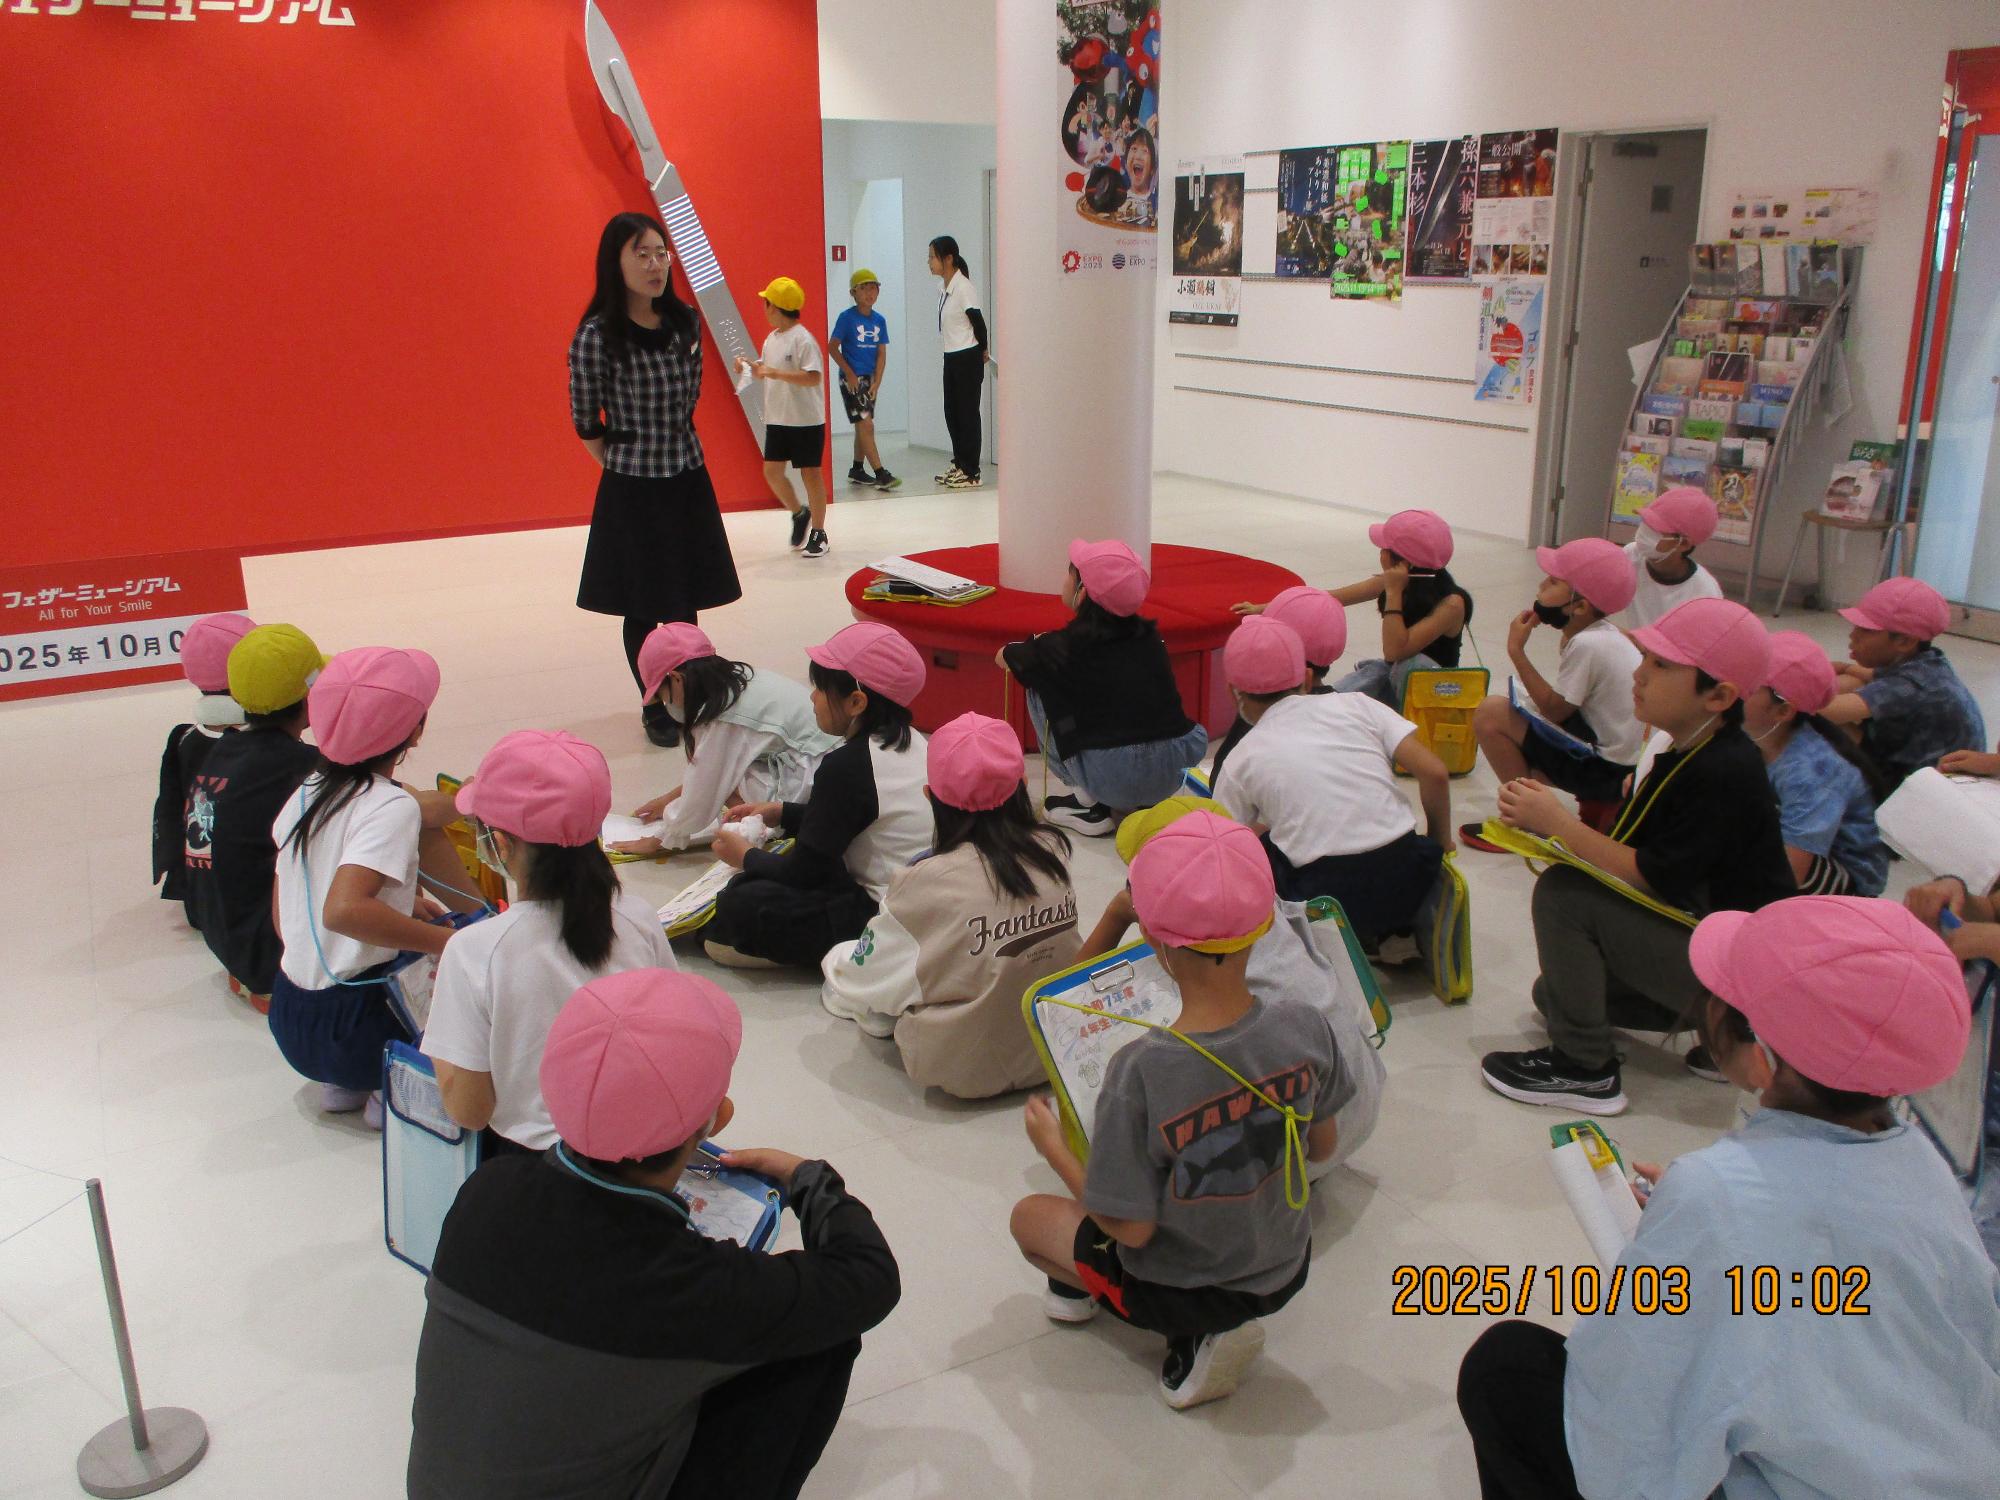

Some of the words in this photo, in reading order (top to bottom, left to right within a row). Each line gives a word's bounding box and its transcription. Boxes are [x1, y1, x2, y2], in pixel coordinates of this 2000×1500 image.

[1409, 142, 1428, 216] 三本杉
[2, 576, 181, 608] フェザーミュージアム
[39, 608, 54, 621] All
[61, 606, 79, 619] for
[85, 602, 112, 616] Your
[119, 599, 153, 613] Smile
